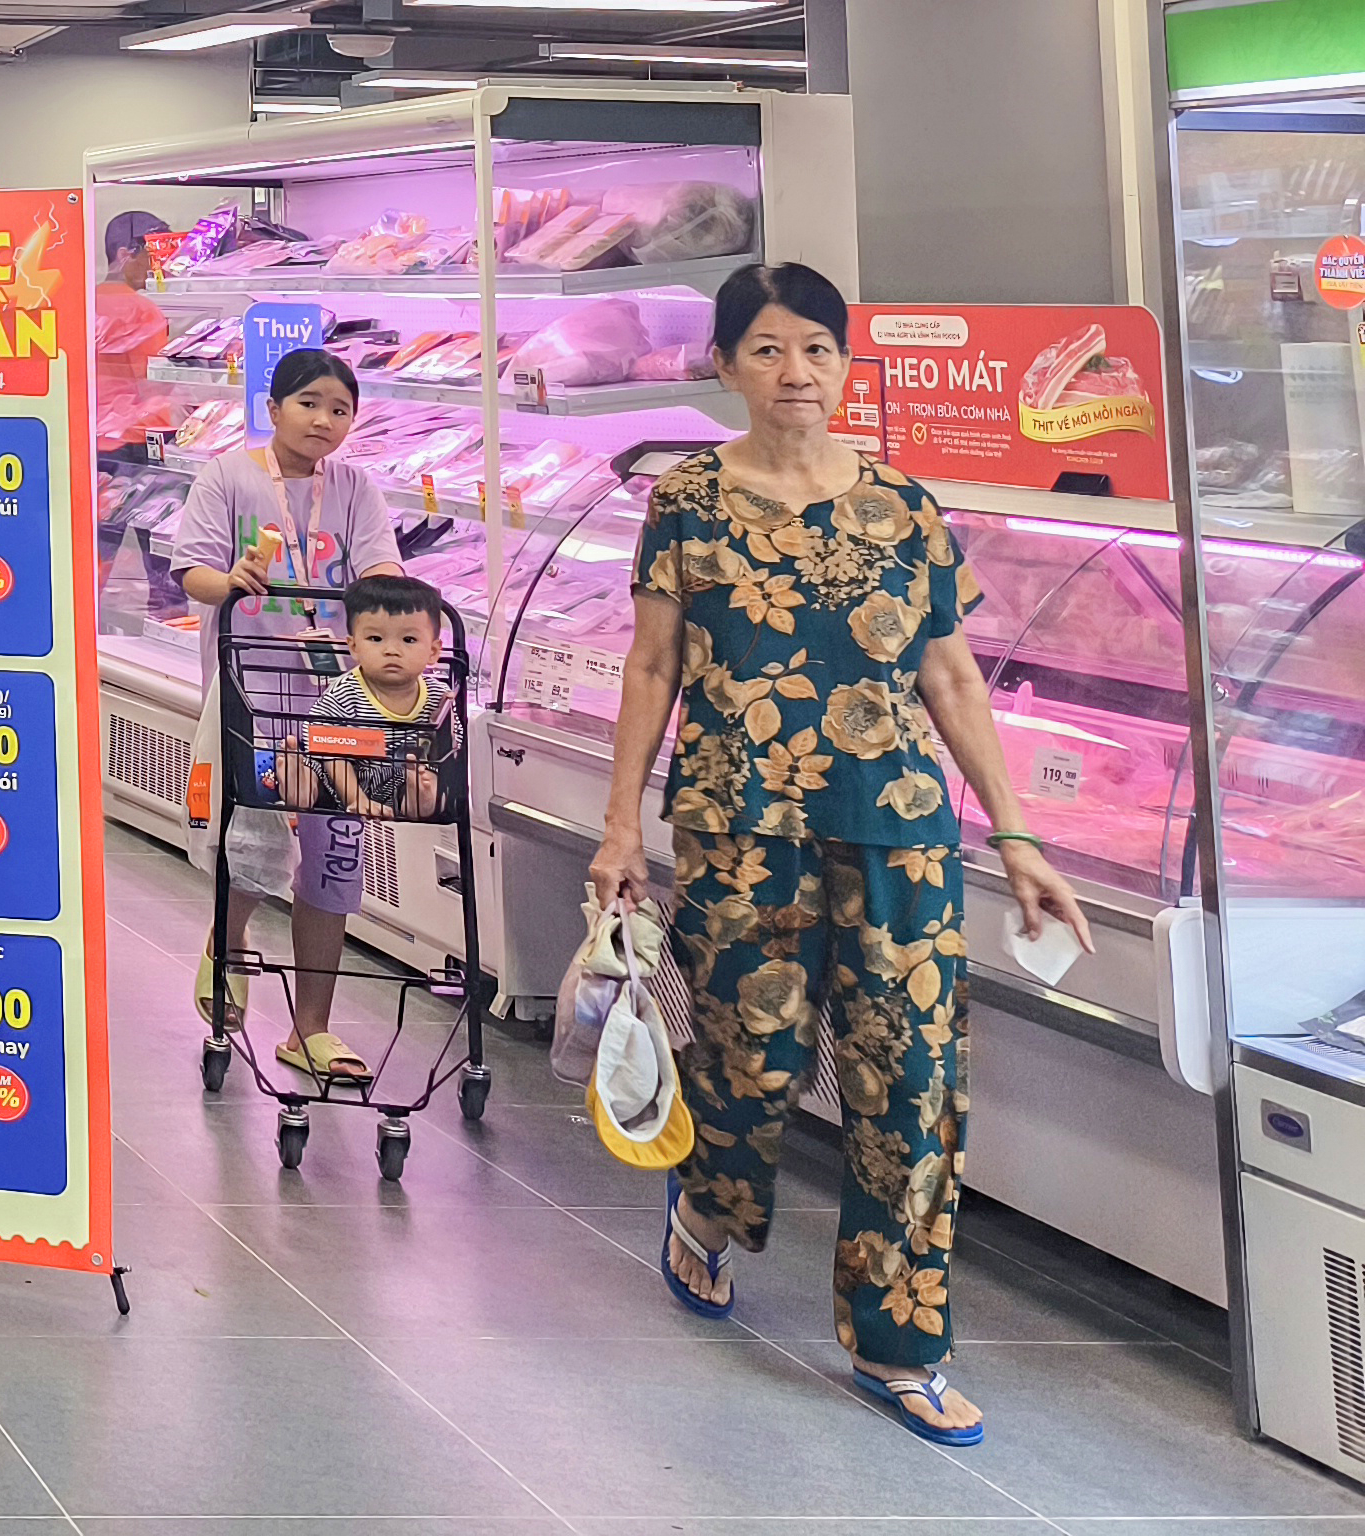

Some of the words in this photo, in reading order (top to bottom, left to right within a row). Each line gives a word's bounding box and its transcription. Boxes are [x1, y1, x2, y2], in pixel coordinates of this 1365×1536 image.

[253, 317, 313, 343] Thuỷ
[884, 357, 939, 390] HEO
[948, 349, 1008, 393] MÁT
[907, 402, 936, 418] TRỌN
[937, 401, 960, 418] BỮA
[961, 405, 985, 420] CƠM
[987, 405, 1011, 421] NHÀ
[1032, 419, 1055, 434] THỊT
